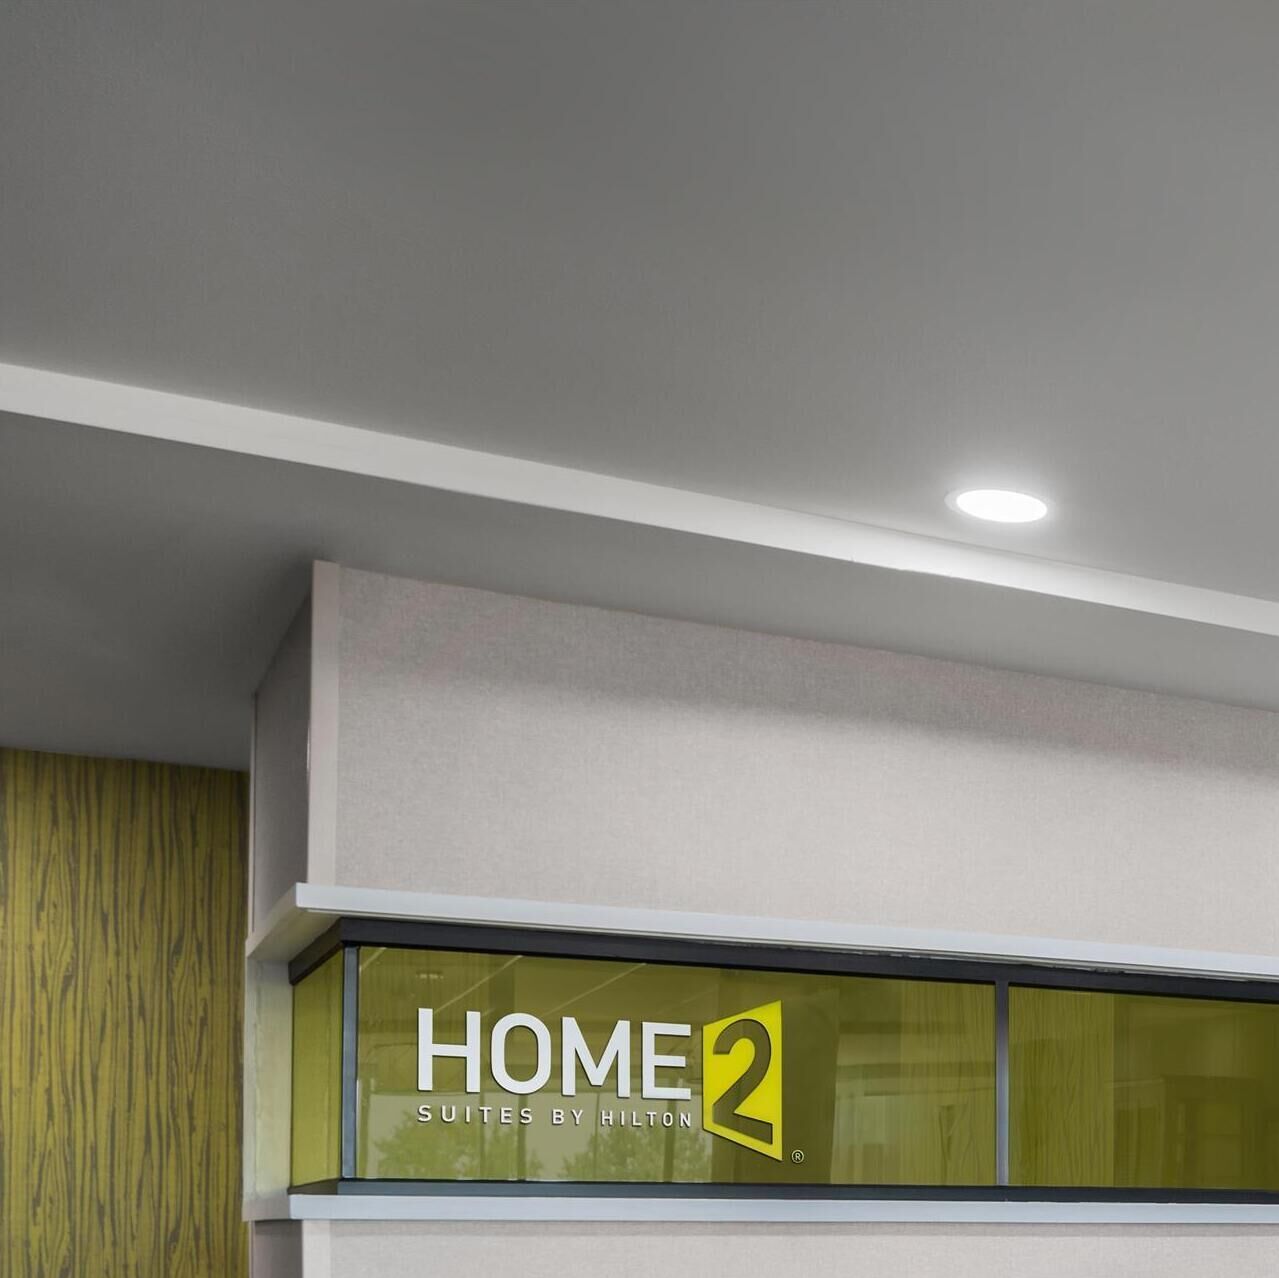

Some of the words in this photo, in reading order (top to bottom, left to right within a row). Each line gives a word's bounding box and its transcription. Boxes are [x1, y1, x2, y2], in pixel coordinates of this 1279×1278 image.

[417, 1007, 692, 1101] HOME
[417, 1104, 533, 1125] SUITES
[551, 1108, 585, 1126] BY
[601, 1110, 692, 1129] HILTON
